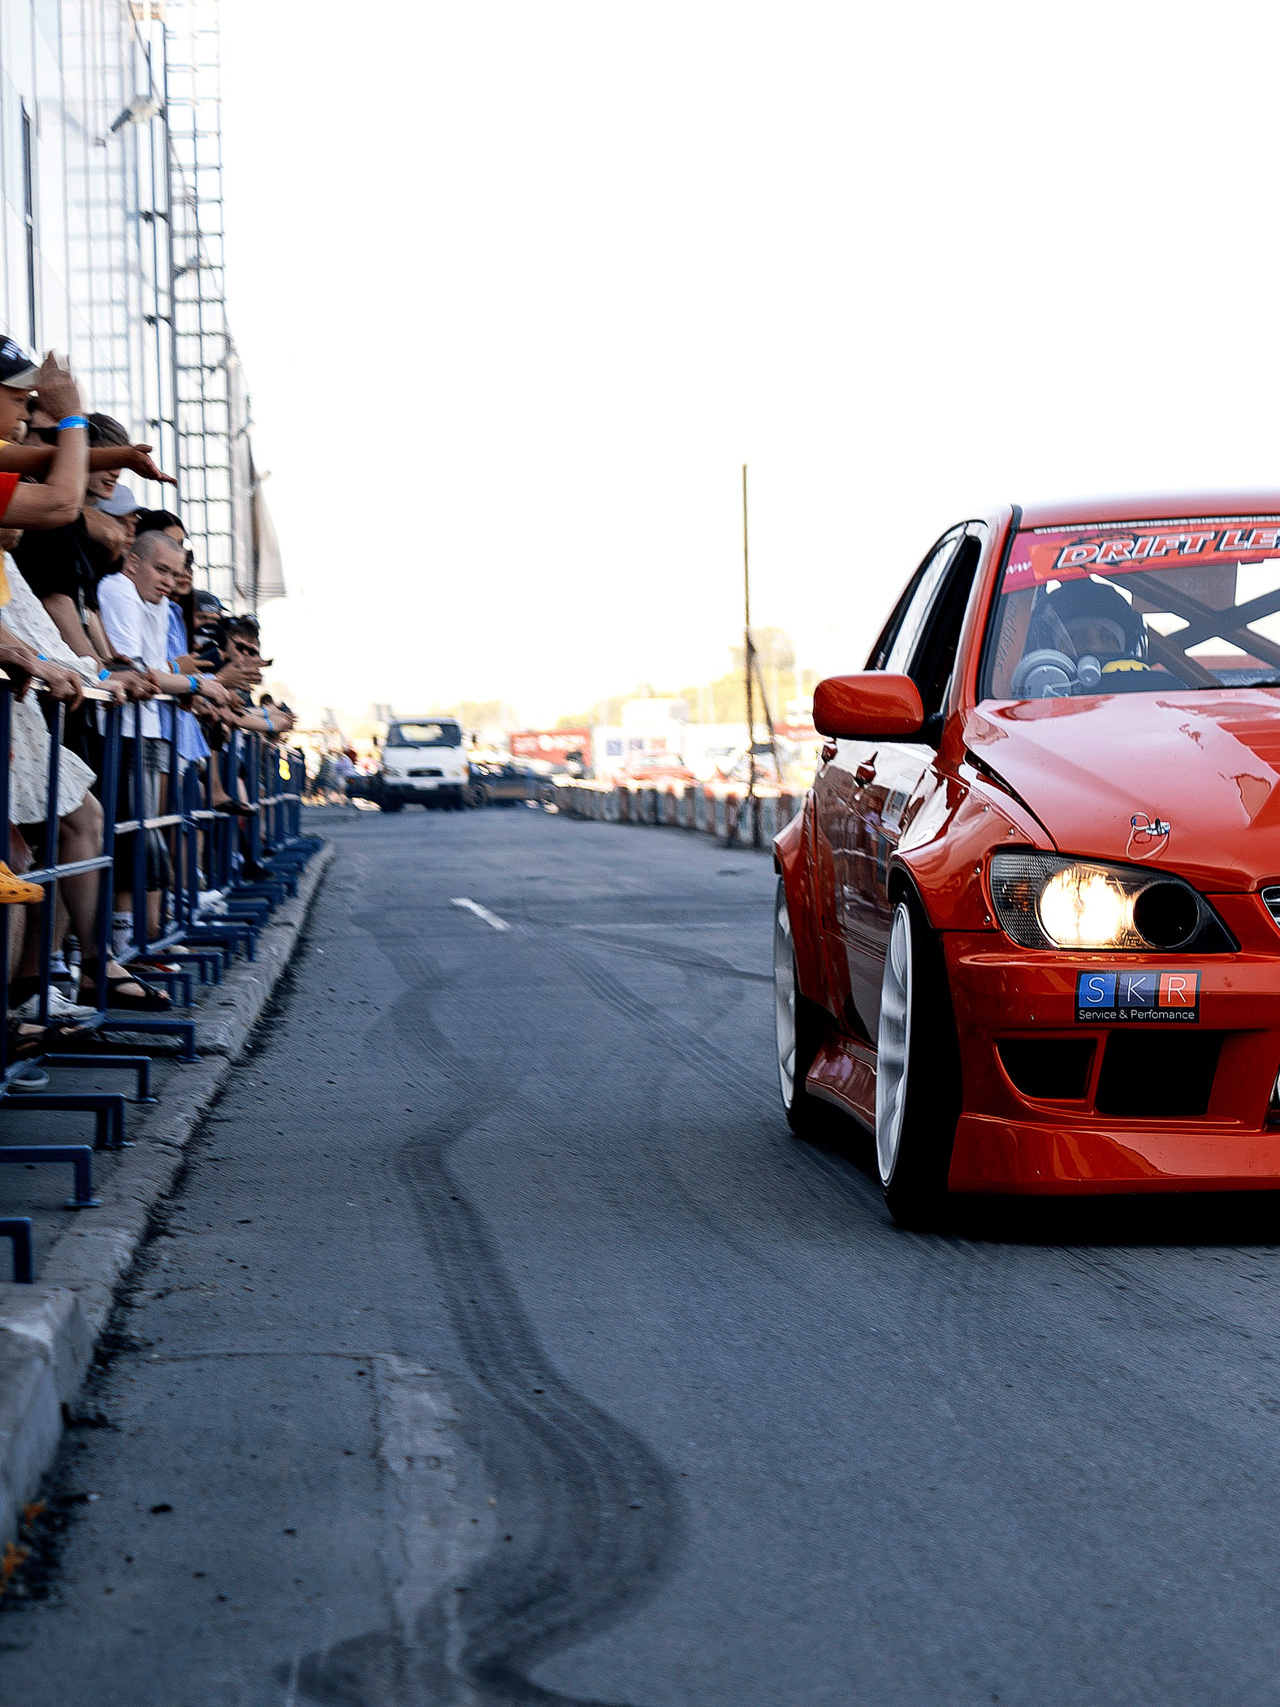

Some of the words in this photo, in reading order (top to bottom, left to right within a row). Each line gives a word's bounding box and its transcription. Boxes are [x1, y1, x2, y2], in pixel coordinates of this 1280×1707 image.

[1055, 530, 1215, 569] DRIFT
[1086, 976, 1187, 1003] SKR
[1078, 1009, 1117, 1020] Service
[1119, 1009, 1128, 1019] &
[1130, 1009, 1195, 1020] Perfomance
